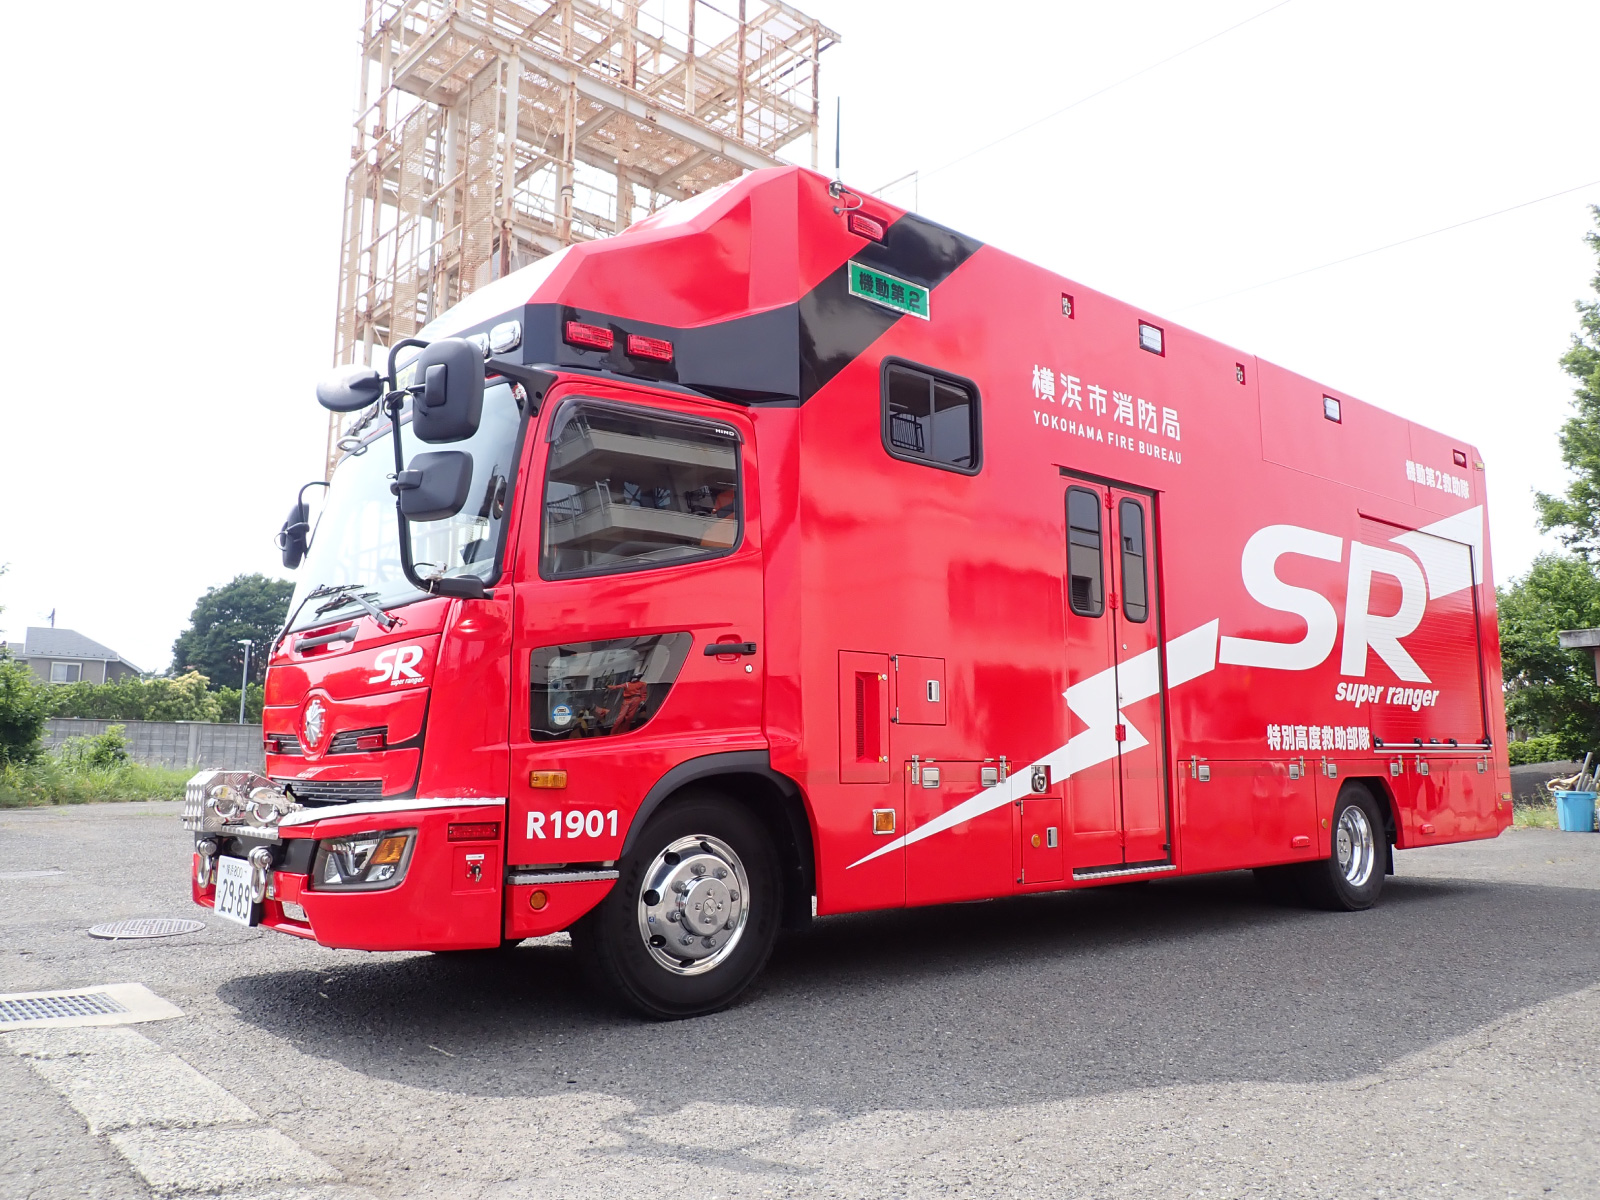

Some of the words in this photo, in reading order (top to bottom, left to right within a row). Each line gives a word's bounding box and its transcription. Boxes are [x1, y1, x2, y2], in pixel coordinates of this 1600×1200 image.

[858, 271, 921, 310] 機動第2
[1032, 364, 1181, 441] 横浜市消防局
[715, 428, 735, 437] HINO
[1033, 410, 1104, 443] YOKOHAMA
[1108, 431, 1135, 451] FIRE
[1138, 441, 1182, 465] BUREAU
[1405, 459, 1470, 499] 機動第2救助隊
[1219, 524, 1433, 684] SR
[368, 645, 424, 684] SR
[1335, 682, 1384, 708] super
[1386, 686, 1440, 712] ranger
[1267, 723, 1371, 750] 特別高度救助部隊
[526, 809, 618, 839] R1901
